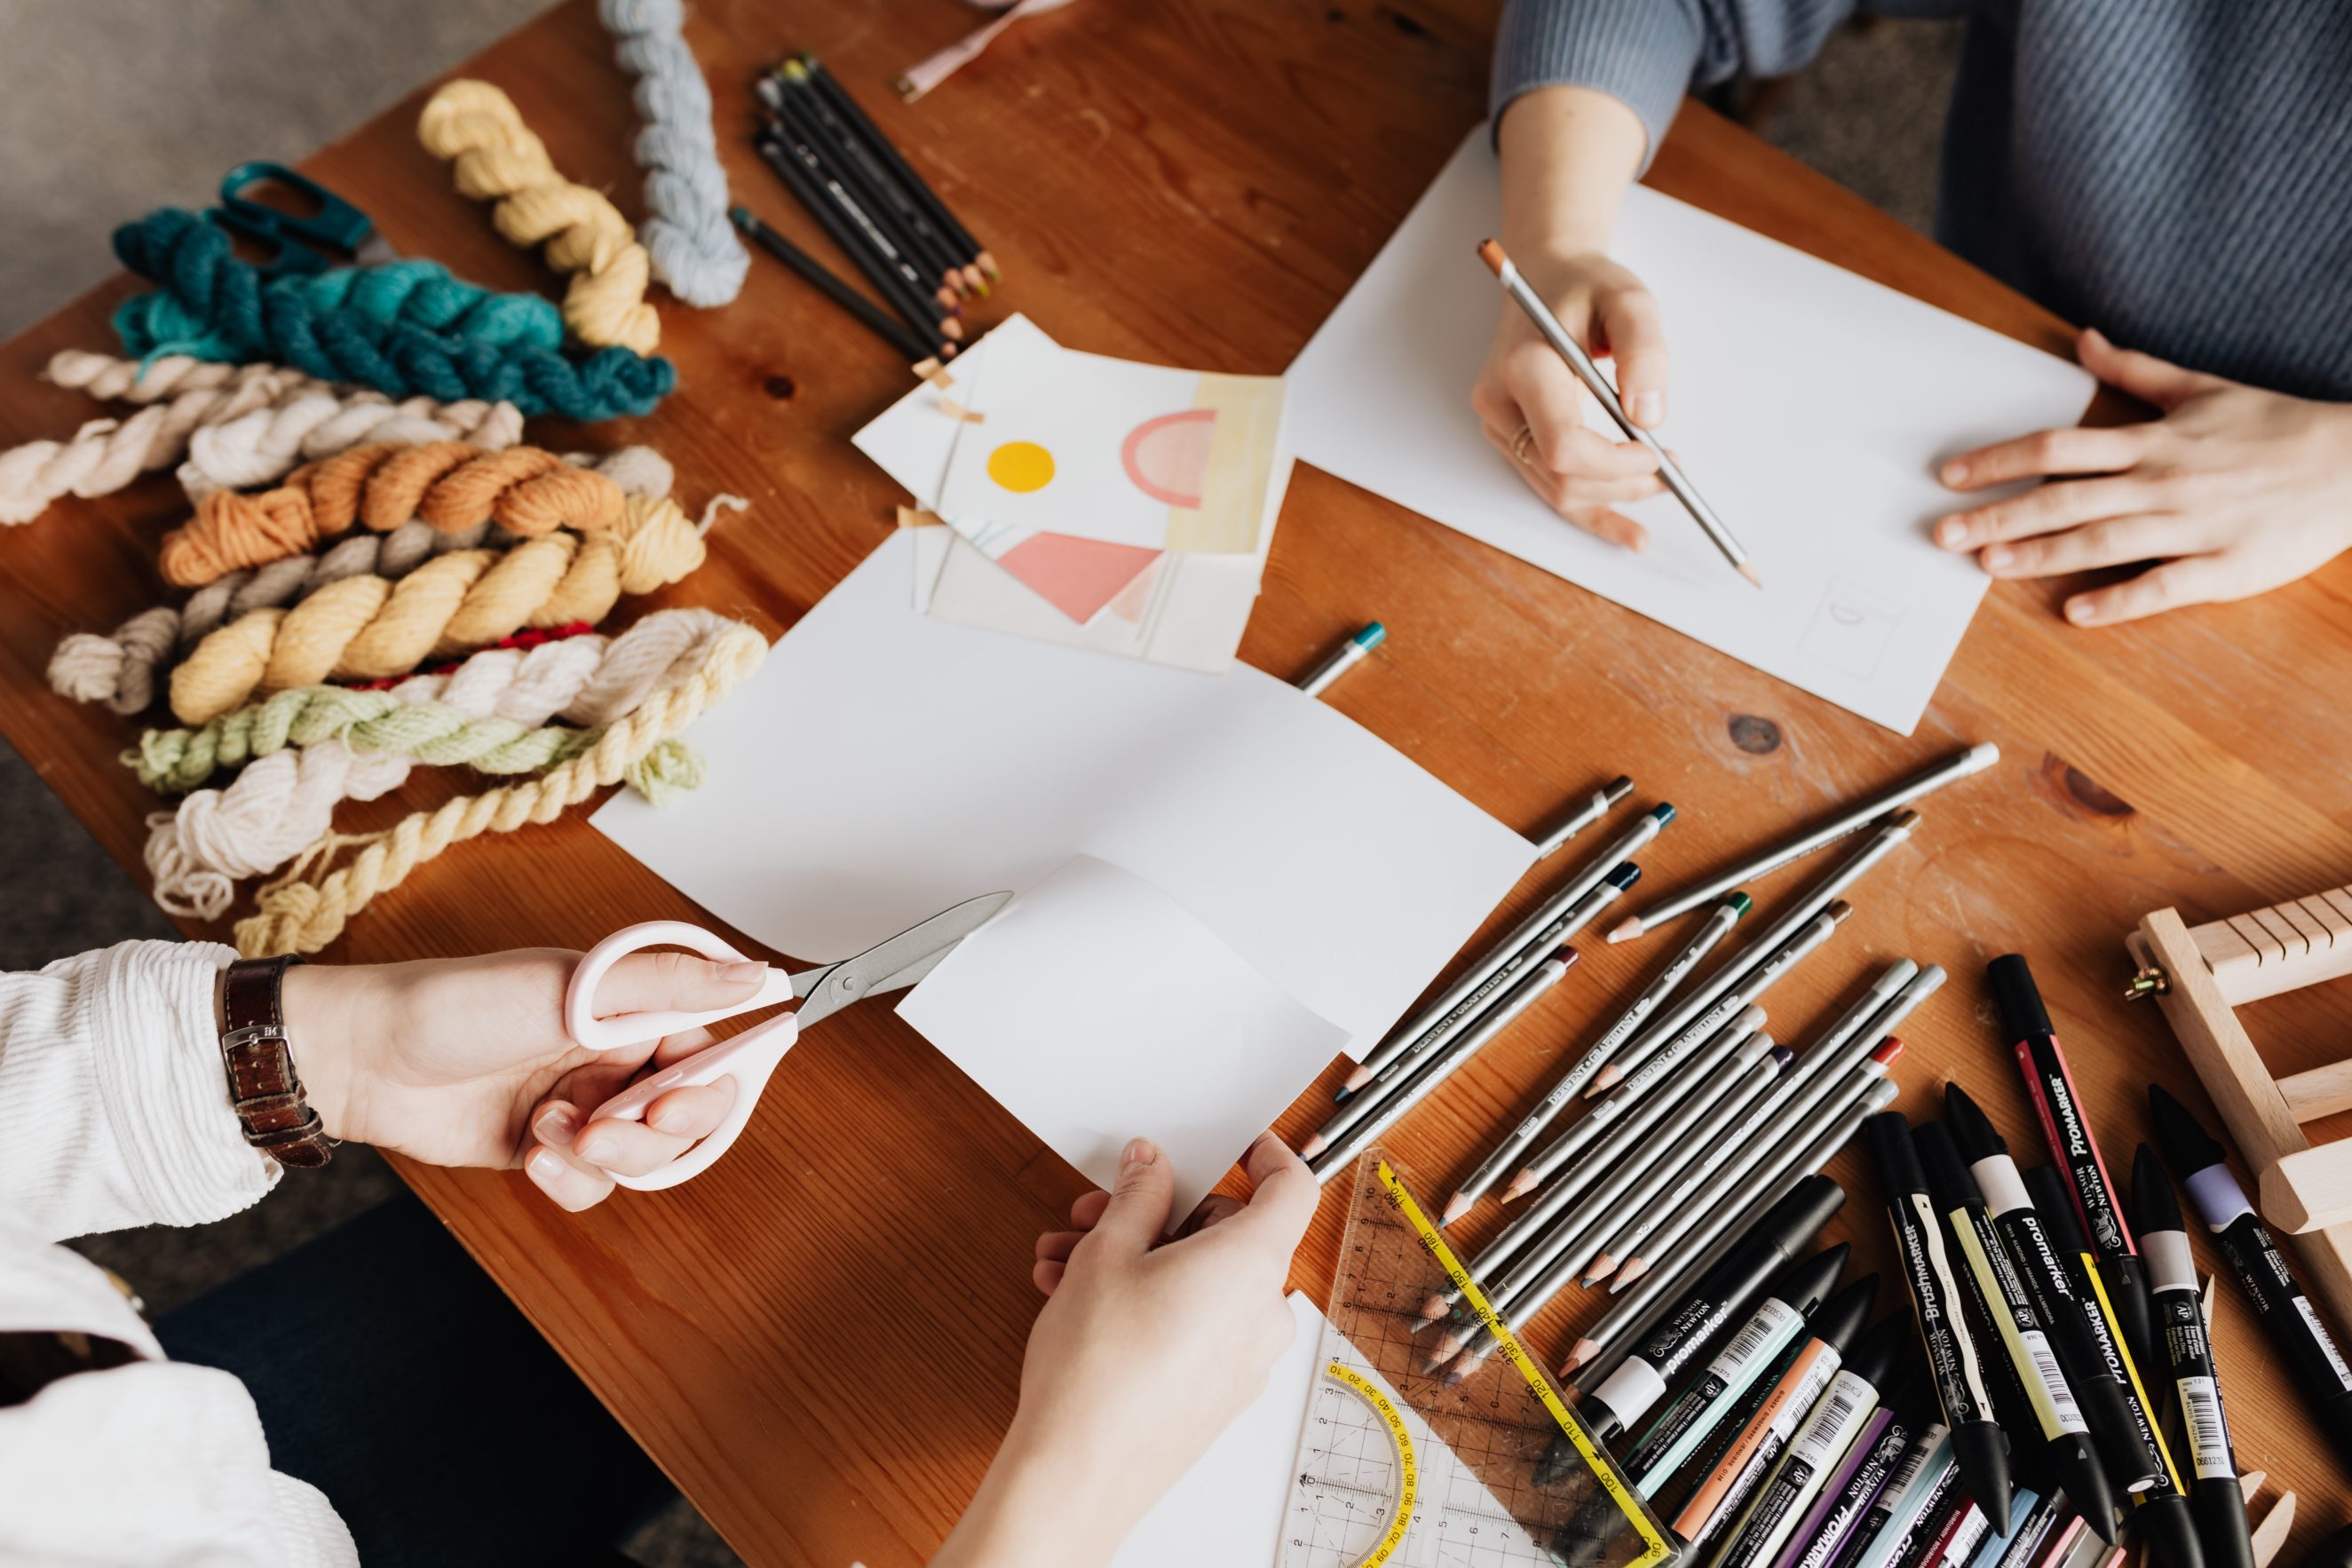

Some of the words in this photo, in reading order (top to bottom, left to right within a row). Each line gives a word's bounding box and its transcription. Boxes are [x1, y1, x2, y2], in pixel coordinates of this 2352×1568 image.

[1547, 1064, 1585, 1105] DERWENT
[1588, 1010, 1637, 1062] GRAPHITINT
[1626, 1055, 1667, 1091] DERWENT
[1670, 1008, 1723, 1057] GRAPHITINT
[1366, 1187, 1375, 1200] 10
[2076, 1167, 2095, 1209] WINSOR
[2087, 1164, 2107, 1207] NEWTON
[2013, 1238, 2026, 1263] ALMOND
[2025, 1266, 2039, 1292] AMANDE
[2038, 1296, 2055, 1326] ALMENDRA
[2246, 1274, 2269, 1312] WINSOR
[1384, 1192, 1401, 1211] 350
[1417, 1237, 1433, 1256] 340
[1497, 1345, 1514, 1366] 310
[1524, 1384, 1541, 1406] 300
[1673, 1299, 1703, 1326] WINSOR
[1680, 1303, 1711, 1333] NEWTON
[2177, 1305, 2187, 1319] AP
[1929, 1334, 1944, 1375] WINSOR
[1939, 1329, 1955, 1371] NEWTON
[1330, 1366, 1342, 1375] 10
[1348, 1374, 1361, 1384] 20
[1390, 1187, 1406, 1205] 170
[1424, 1231, 1439, 1250] 160
[1453, 1270, 1469, 1289] 150
[1477, 1306, 1493, 1326] 140
[1504, 1342, 1519, 1361] 130
[1532, 1379, 1549, 1399] 120
[1564, 1421, 1578, 1442] 110
[1601, 1472, 1618, 1493] 100
[1651, 1542, 1661, 1558] 90
[1719, 1368, 1730, 1378] 275
[1364, 1384, 1377, 1397] 30
[1705, 1381, 1717, 1395] AP
[1770, 1390, 1785, 1409] GINGER
[1378, 1398, 1391, 1411] 40
[1390, 1415, 1401, 1429] 50
[1748, 1411, 1770, 1440] GINGEMBRE
[2126, 1396, 2152, 1440] NEWTON
[1398, 1433, 1409, 1447] 60
[1404, 1453, 1414, 1465] 70
[1729, 1441, 1747, 1466] JENGIBRE
[1406, 1473, 1414, 1487] 80
[1793, 1469, 1805, 1483] AP
[1849, 1458, 1879, 1499] NEWTON
[1405, 1493, 1414, 1506] 90
[1916, 1485, 1944, 1527] NEWTON
[1345, 1501, 1354, 1509] 2
[1376, 1508, 1385, 1517] 3
[1501, 1532, 1510, 1540] 7
[1398, 1512, 1408, 1526] 80
[1942, 1509, 1961, 1537] BURGUNDY
[1389, 1532, 1400, 1546] 70
[1376, 1548, 1389, 1563] 60
